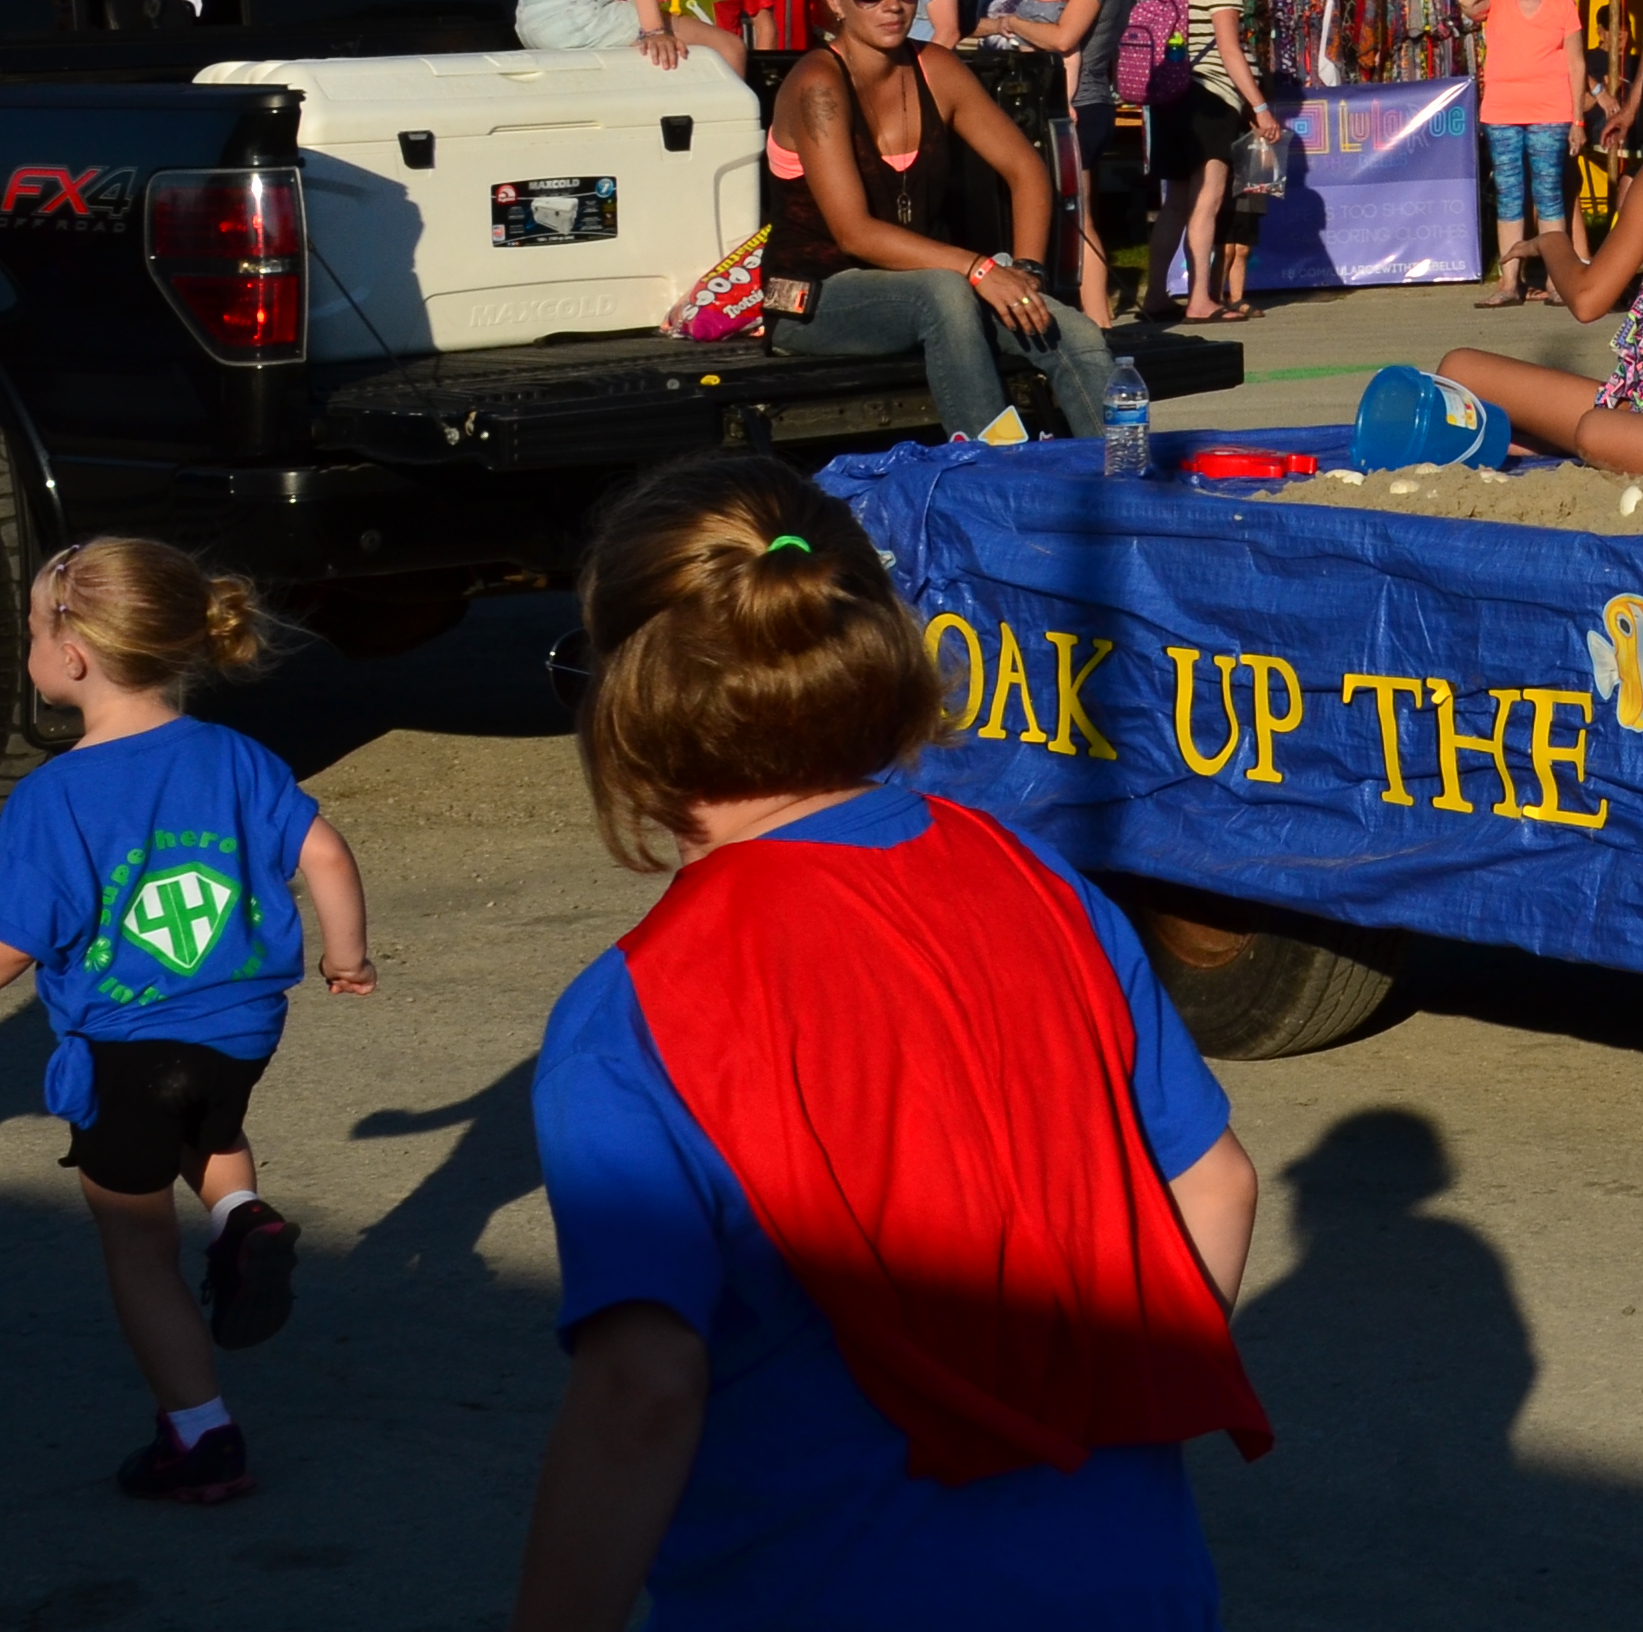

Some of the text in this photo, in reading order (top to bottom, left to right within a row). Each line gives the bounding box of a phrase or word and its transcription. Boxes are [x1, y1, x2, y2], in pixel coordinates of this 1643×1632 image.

[0, 164, 138, 218] FX4
[528, 179, 580, 190] MAXCOLD
[54, 219, 127, 233] ROAD
[470, 294, 617, 328] MAXCOLD
[1166, 644, 1304, 784] UP
[1341, 673, 1608, 830] THE
